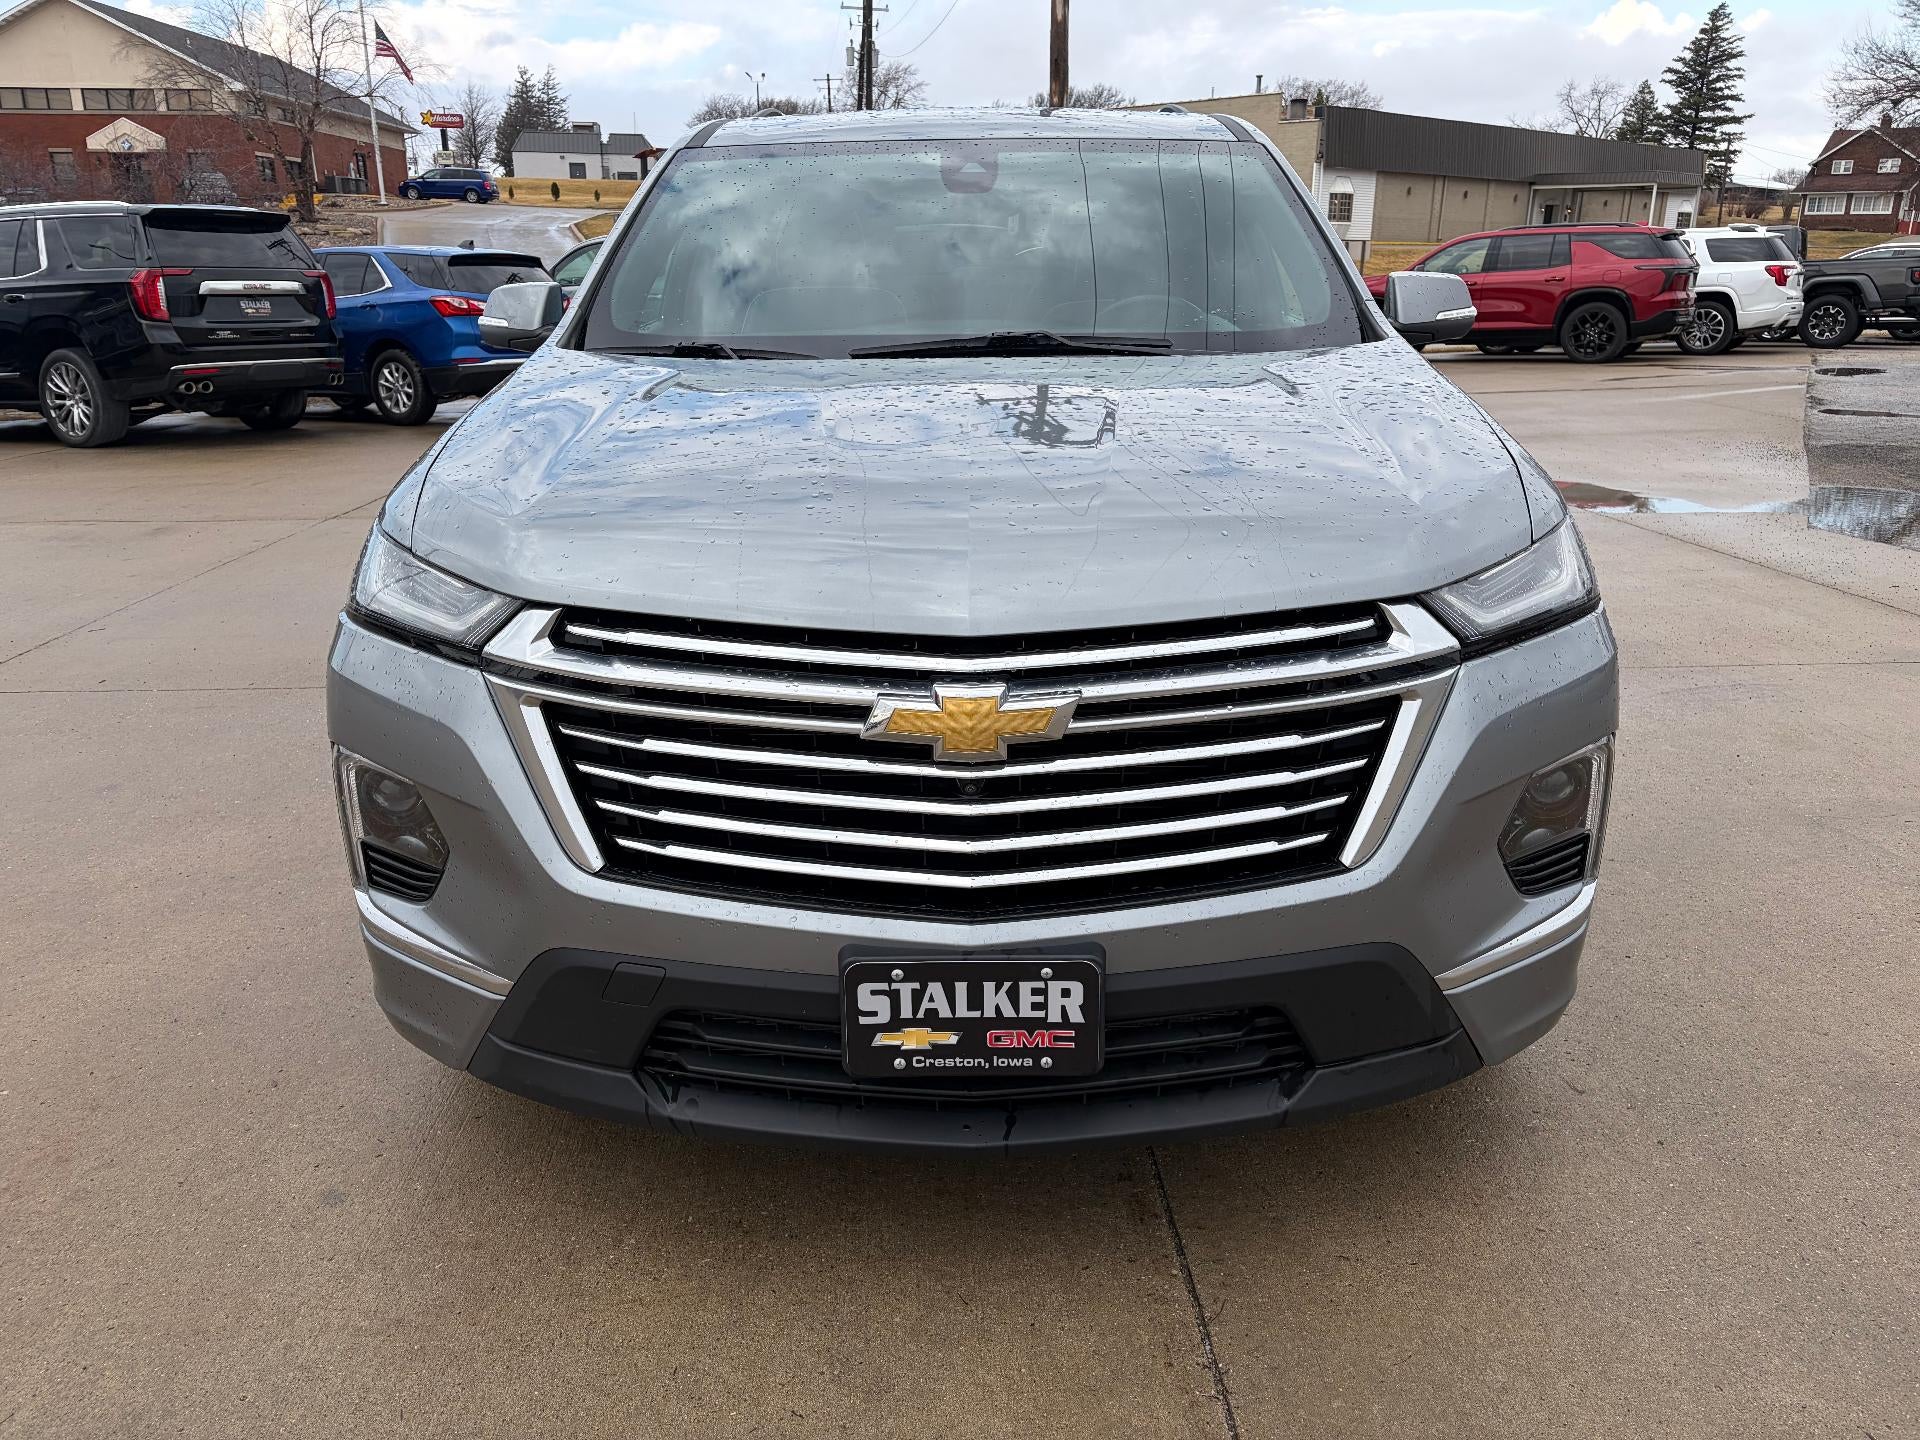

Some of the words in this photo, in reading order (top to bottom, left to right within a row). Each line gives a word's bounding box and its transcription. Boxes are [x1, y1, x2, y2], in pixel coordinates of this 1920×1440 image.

[240, 300, 271, 309] STALKER
[857, 980, 1086, 1025] STALKER
[986, 1029, 1076, 1049] GMC
[912, 1055, 990, 1069] Creston,
[993, 1055, 1033, 1068] Iowa
